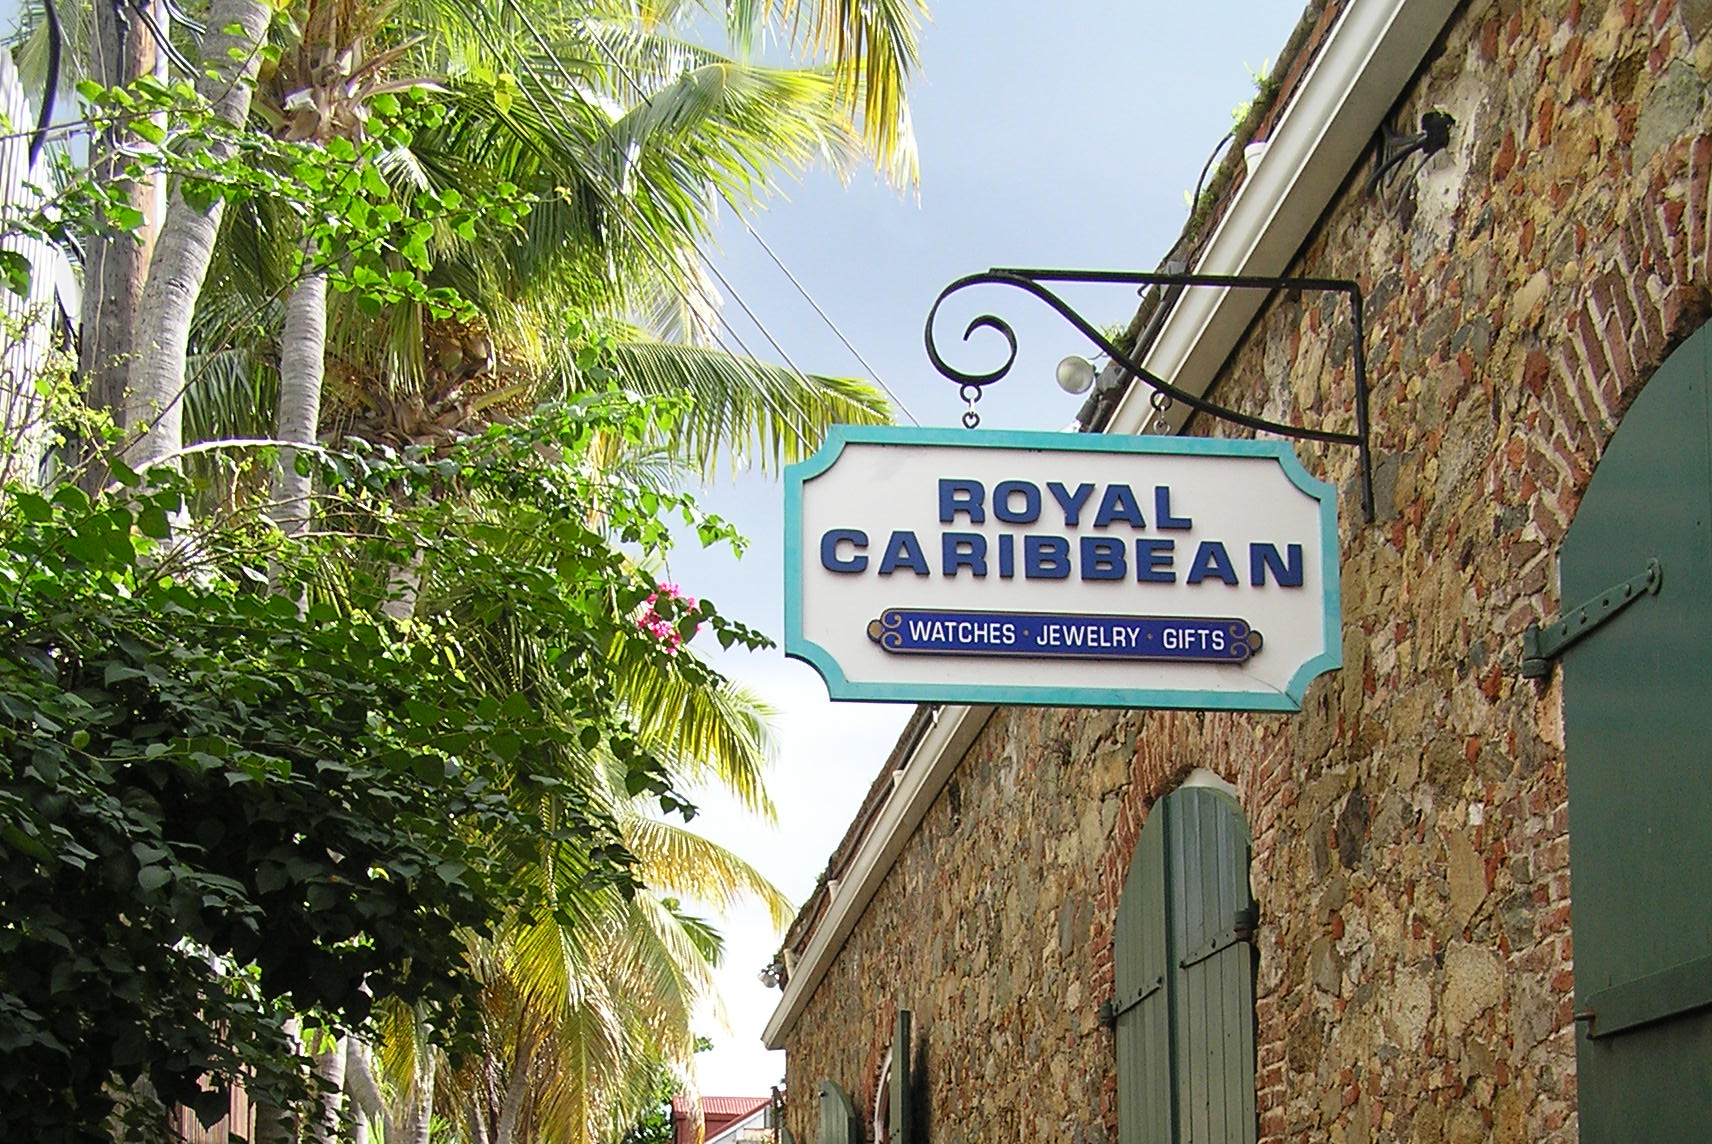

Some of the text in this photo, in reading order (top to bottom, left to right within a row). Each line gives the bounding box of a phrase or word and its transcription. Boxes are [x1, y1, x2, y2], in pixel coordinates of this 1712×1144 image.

[938, 478, 1193, 530] ROYAL
[819, 528, 1304, 588] CARIBBEAN
[908, 619, 1226, 651] WATCHES JEWELRY GIFTS
